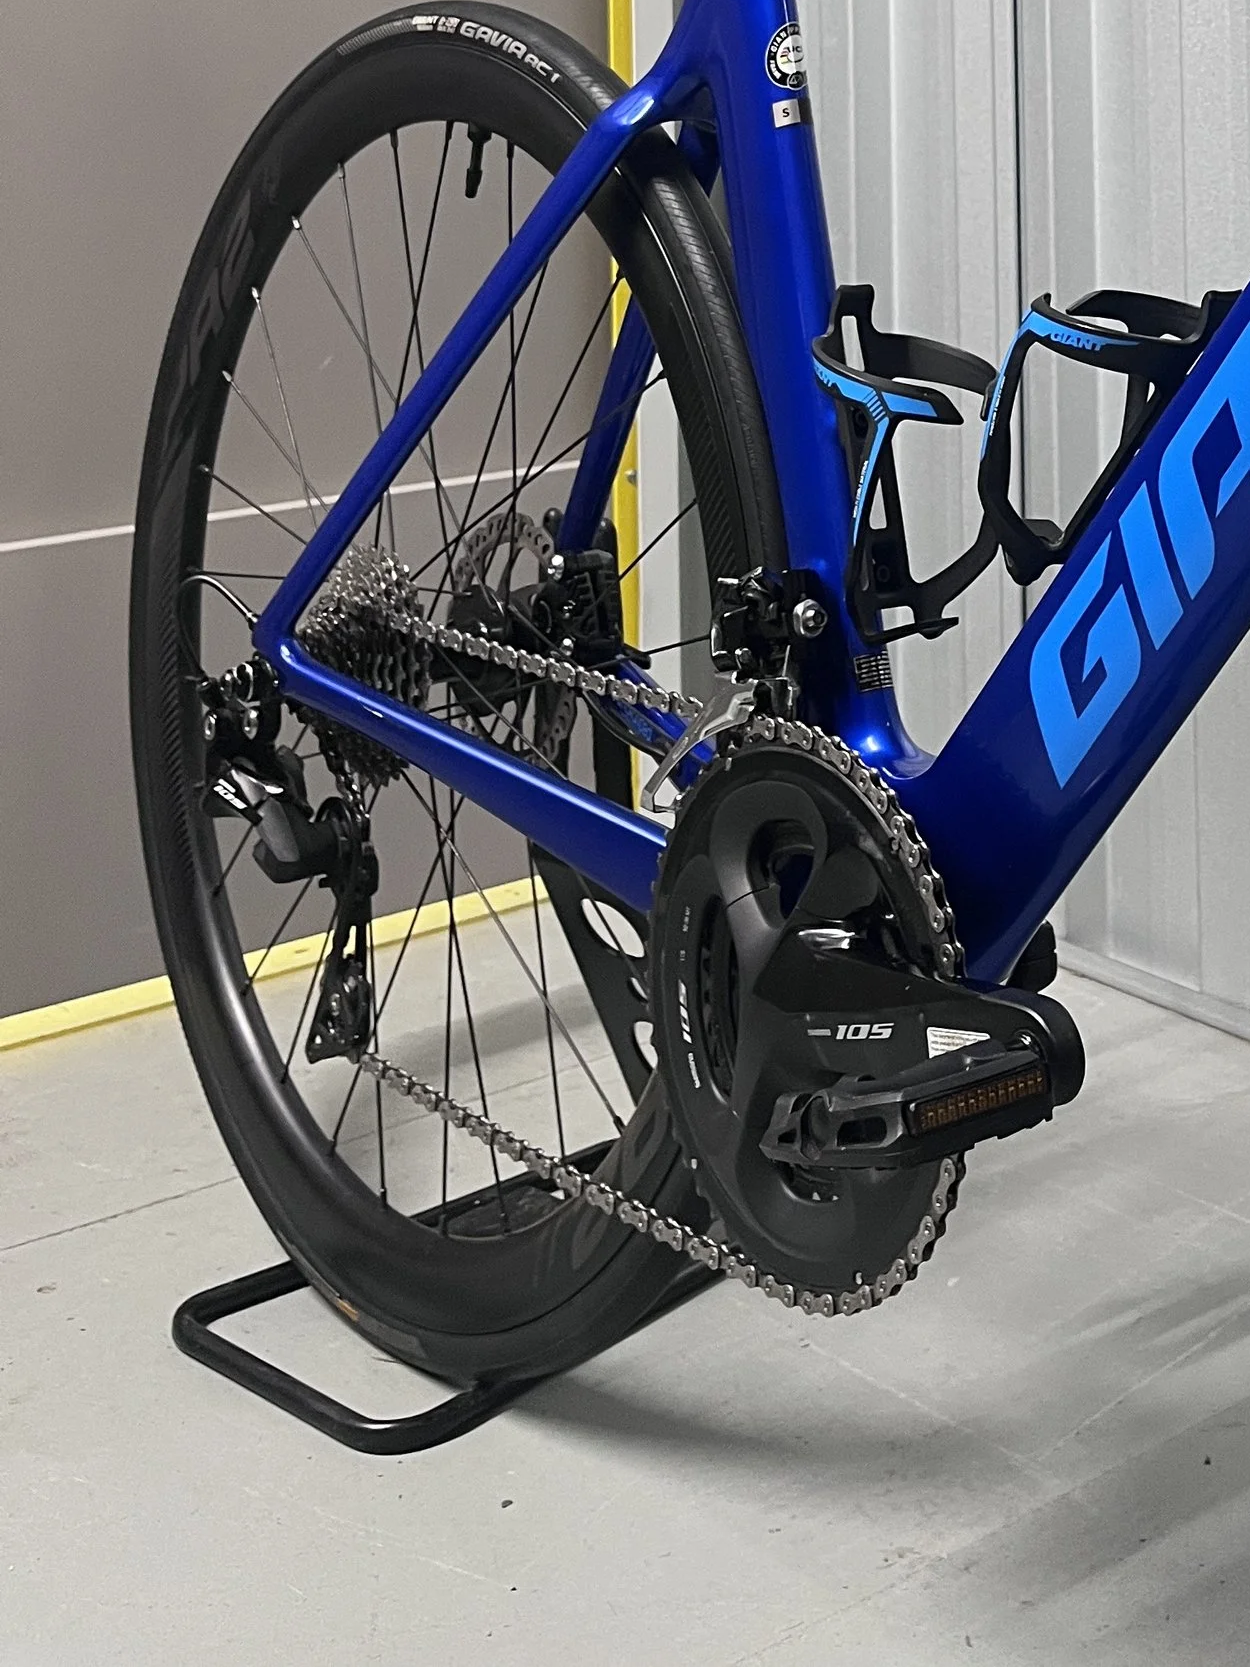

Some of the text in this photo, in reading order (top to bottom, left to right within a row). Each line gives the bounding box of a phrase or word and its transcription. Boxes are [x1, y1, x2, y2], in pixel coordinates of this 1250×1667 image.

[459, 20, 528, 60] GAVIA
[782, 107, 790, 118] S
[1050, 332, 1105, 352] GIANT
[835, 1022, 895, 1041] 105
